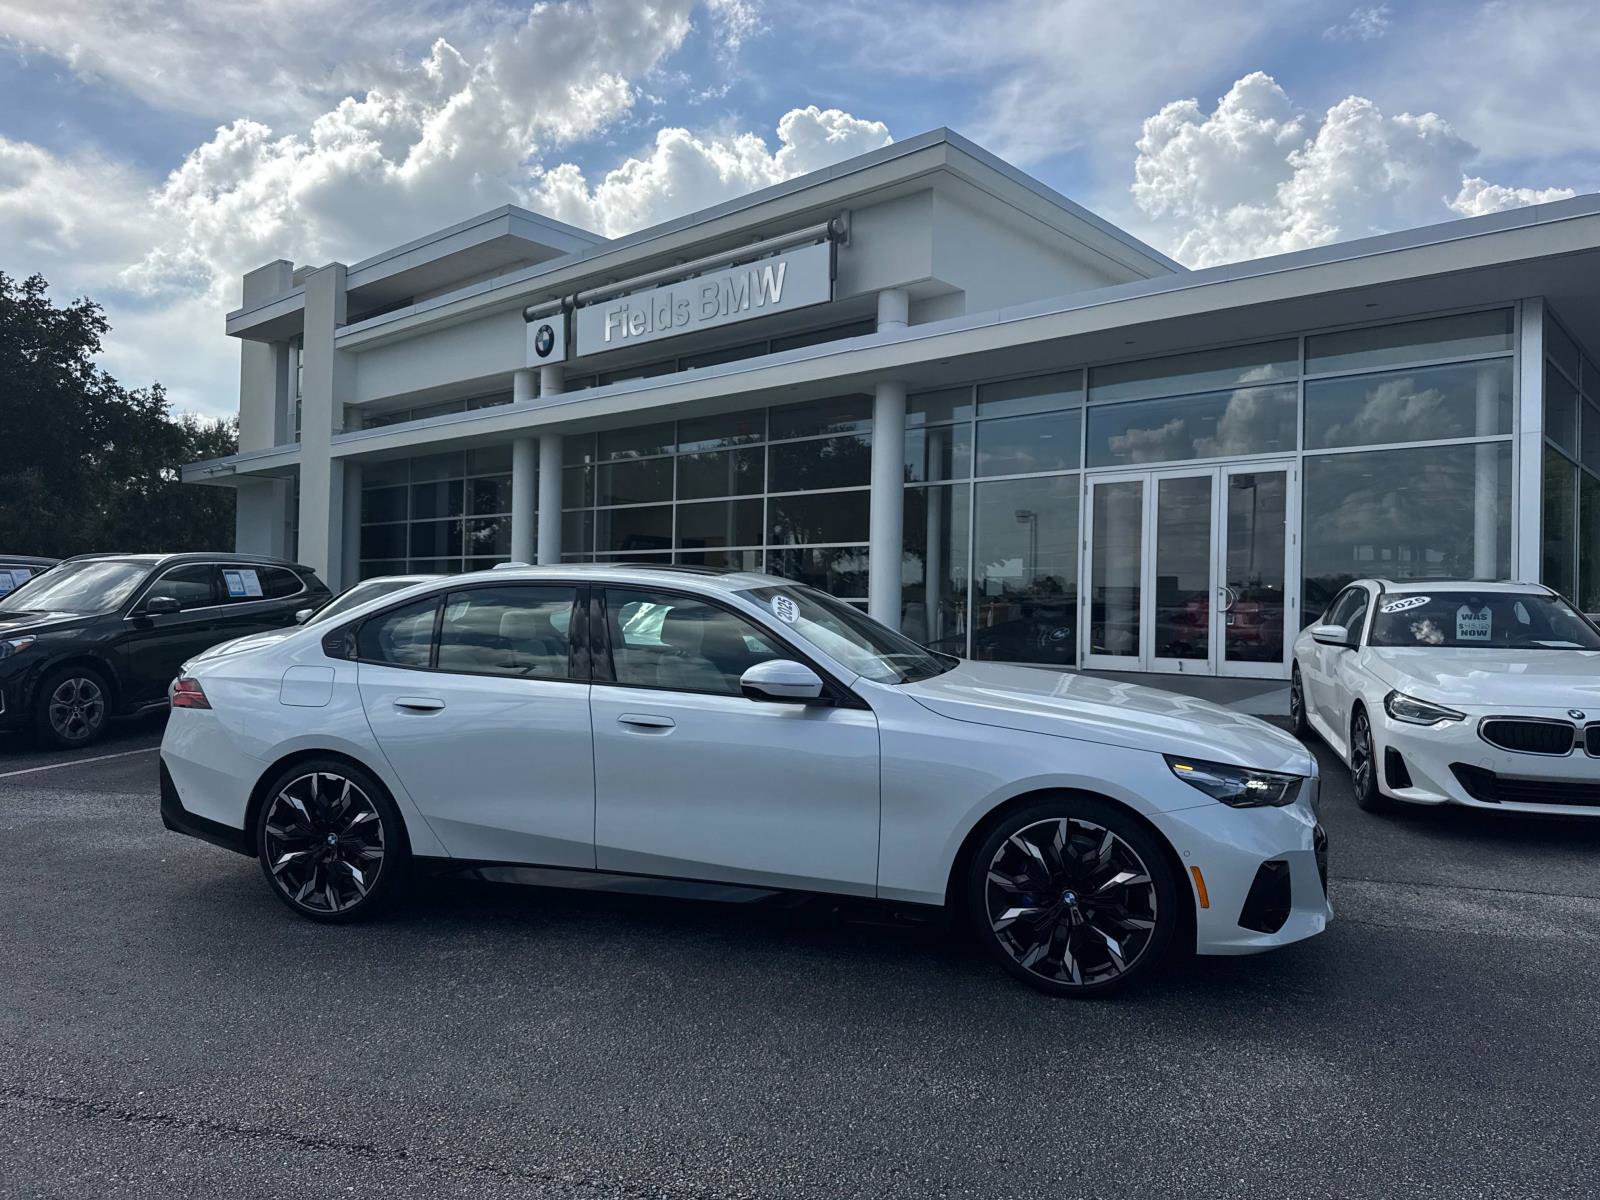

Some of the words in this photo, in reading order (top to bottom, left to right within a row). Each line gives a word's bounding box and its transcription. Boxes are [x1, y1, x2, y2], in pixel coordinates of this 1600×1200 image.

[604, 293, 690, 342] Fields
[699, 261, 787, 321] BMW
[777, 597, 792, 621] 2025
[1385, 597, 1425, 612] 2025
